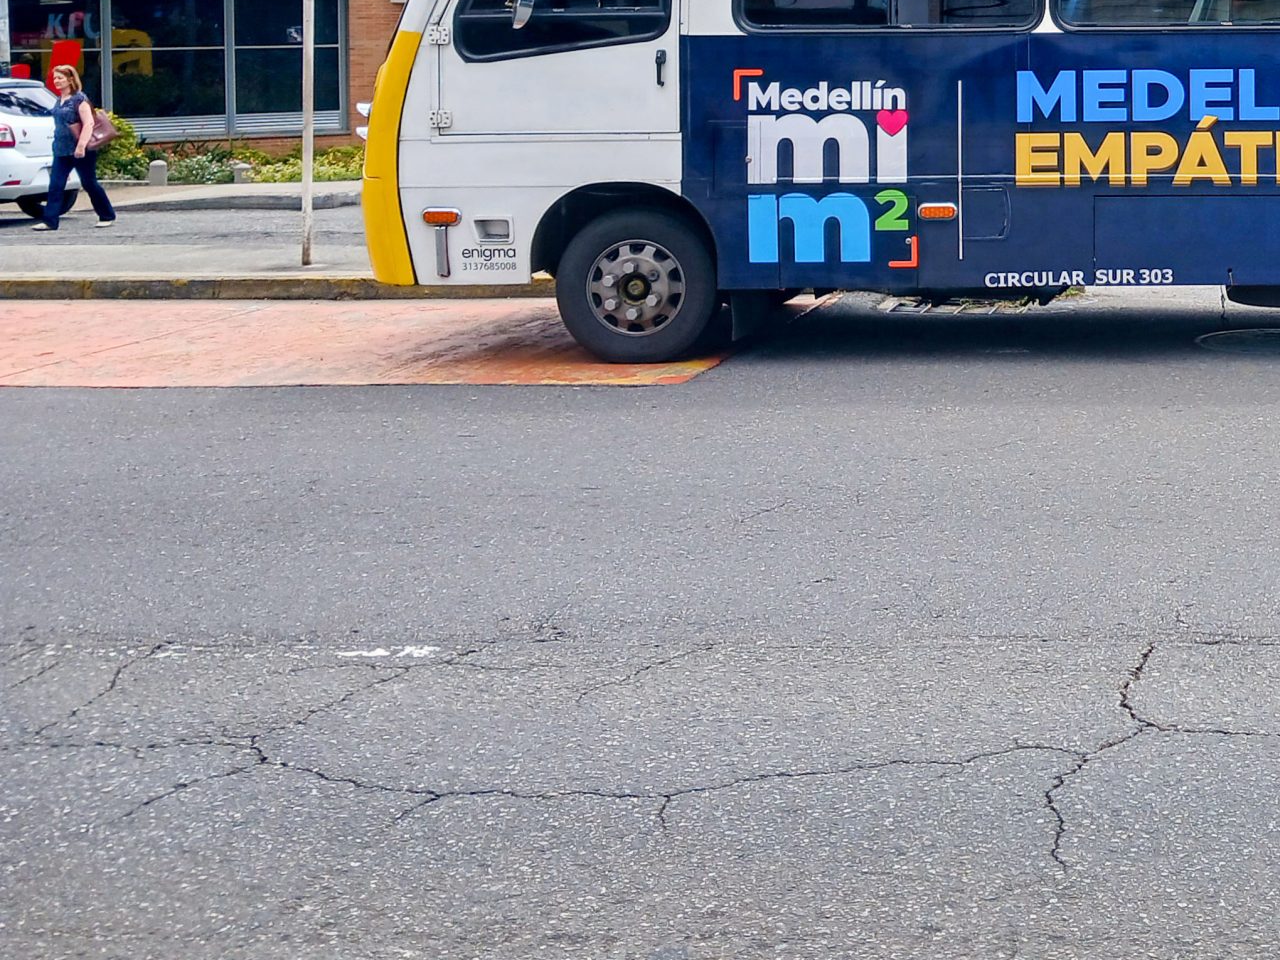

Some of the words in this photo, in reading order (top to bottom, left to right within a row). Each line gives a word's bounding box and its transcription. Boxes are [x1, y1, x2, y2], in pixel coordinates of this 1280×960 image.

[748, 80, 906, 110] Medellín
[747, 112, 908, 184] mi
[462, 245, 516, 261] enigma
[462, 262, 517, 271] 3137685008
[984, 270, 1085, 287] CIRCULAR
[1095, 269, 1136, 284] SUR
[1139, 268, 1174, 284] 303
